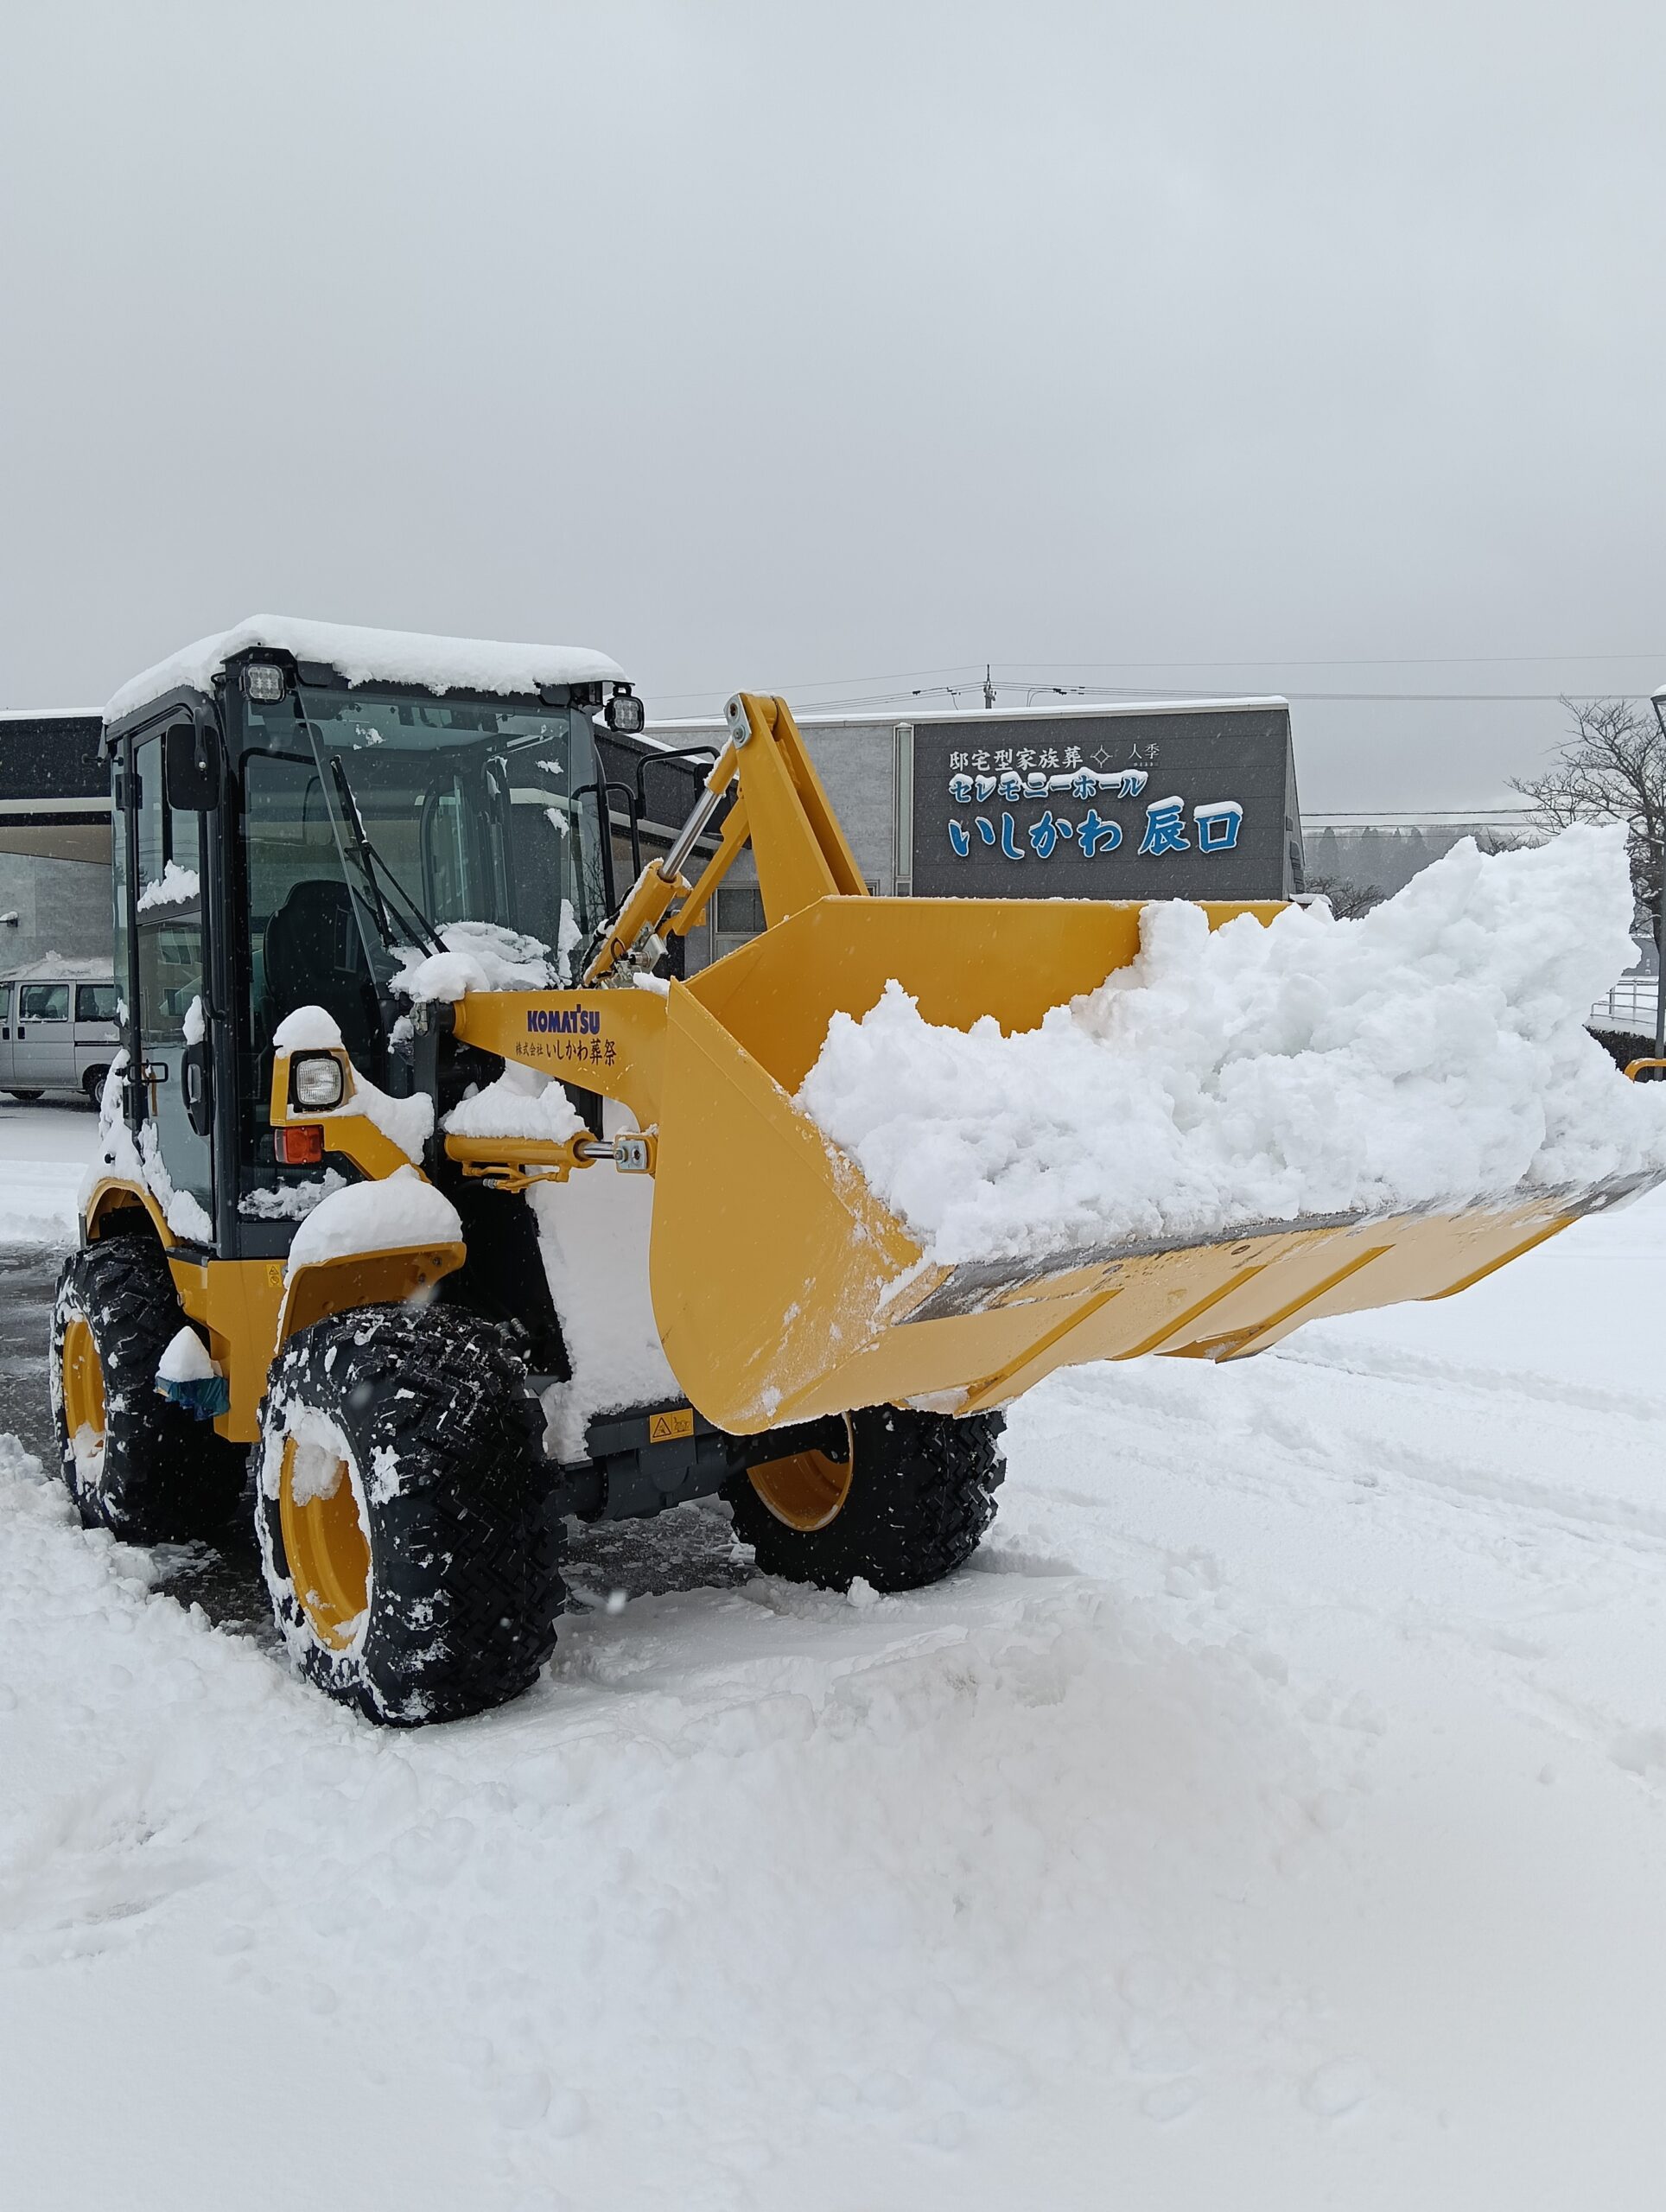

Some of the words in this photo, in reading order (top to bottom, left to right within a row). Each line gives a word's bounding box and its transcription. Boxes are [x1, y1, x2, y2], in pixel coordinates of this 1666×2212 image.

[950, 746, 1084, 772] 邸宅型家族葬
[949, 772, 1147, 803] セレモニーホール
[949, 809, 1122, 859] いしかわ
[1138, 803, 1243, 855] 辰口
[527, 1004, 601, 1034] KOMATSU
